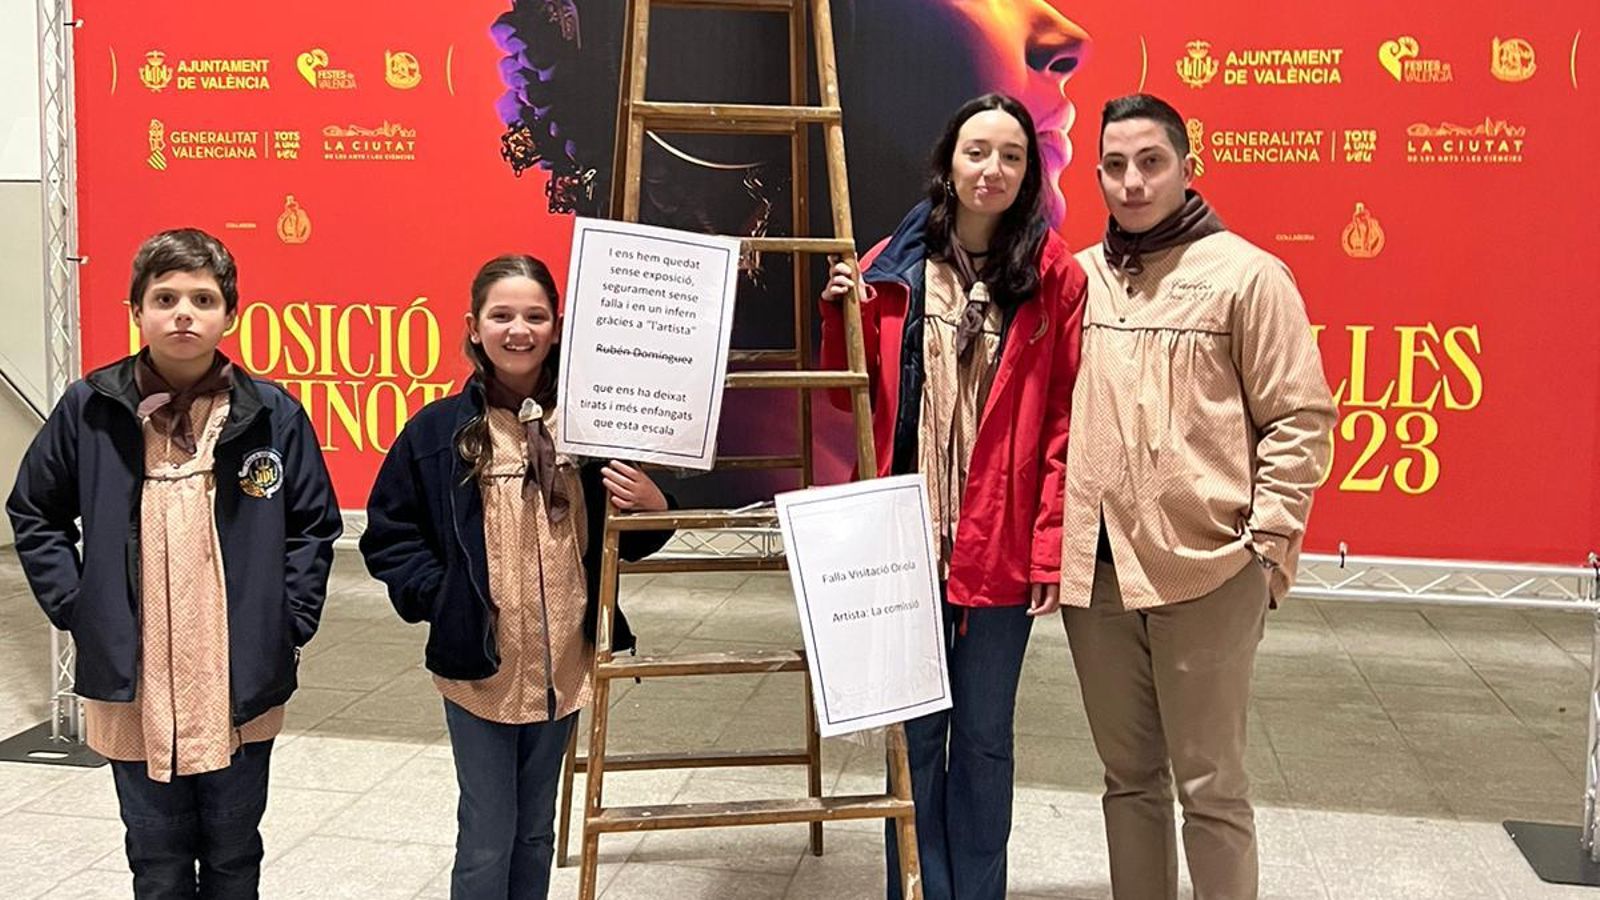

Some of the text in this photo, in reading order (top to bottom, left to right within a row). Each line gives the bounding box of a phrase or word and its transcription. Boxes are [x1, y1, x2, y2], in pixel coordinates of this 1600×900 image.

[177, 59, 270, 73] AJUNTAMENT
[1225, 49, 1343, 66] AJUNTAMENT
[177, 73, 270, 90] DE VALÈNCIA
[318, 69, 346, 80] FESTES
[1224, 65, 1342, 85] DE VALÈNCIA
[170, 131, 259, 144] GENERALITAT
[274, 130, 301, 141] TOTS
[1211, 130, 1323, 147] GENERALITAT
[1343, 130, 1377, 142] TOTS
[171, 146, 257, 159] VALENCIANA
[324, 140, 415, 151] LA CIUTAT
[1408, 140, 1523, 152] LA CIUTAT
[1212, 148, 1320, 163] VALENCIANA
[615, 249, 634, 260] ens
[636, 251, 661, 263] hem
[663, 256, 700, 270] quedat
[610, 266, 695, 287] sense exposició,
[602, 281, 699, 304] segurament sense
[600, 296, 624, 309] falla
[631, 303, 646, 312] en
[648, 305, 662, 314] un
[664, 306, 697, 319] infern
[595, 315, 634, 328] gràcies
[636, 321, 643, 329] a
[596, 343, 631, 356] Rubén
[593, 383, 687, 403] que ens ha deixat
[580, 398, 607, 411] tirats
[615, 402, 639, 414] més
[640, 406, 693, 421] enfangats
[593, 418, 675, 437] que esta escala
[1318, 409, 1441, 495] 23
[822, 571, 847, 584] Falla
[848, 564, 890, 580] Visitació
[832, 599, 920, 623] Artista: La comissió
